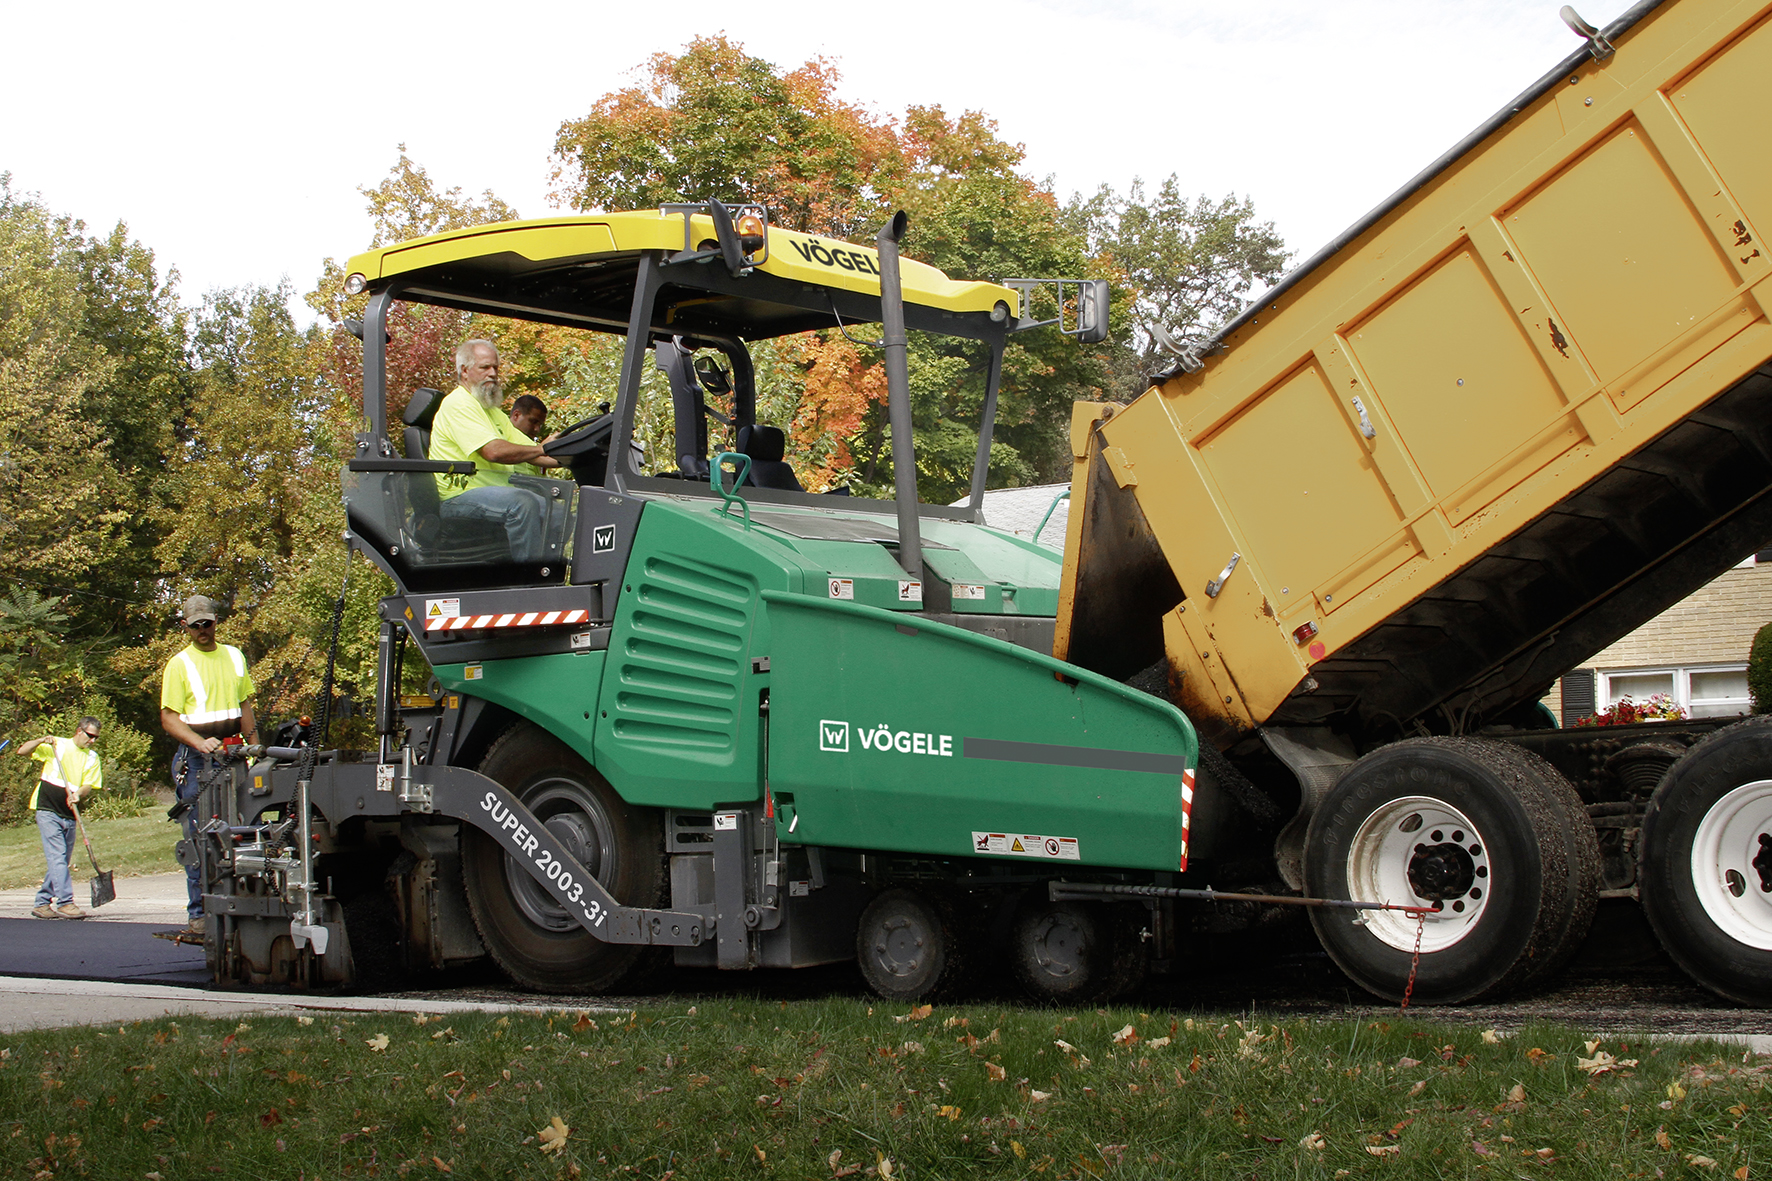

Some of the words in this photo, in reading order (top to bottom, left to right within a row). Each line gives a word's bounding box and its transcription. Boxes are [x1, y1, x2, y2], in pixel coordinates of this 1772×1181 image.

[789, 238, 880, 275] VÖGEL
[857, 723, 953, 757] VÖGELE
[480, 791, 539, 858] SUPER
[534, 849, 608, 928] 2003-3i
